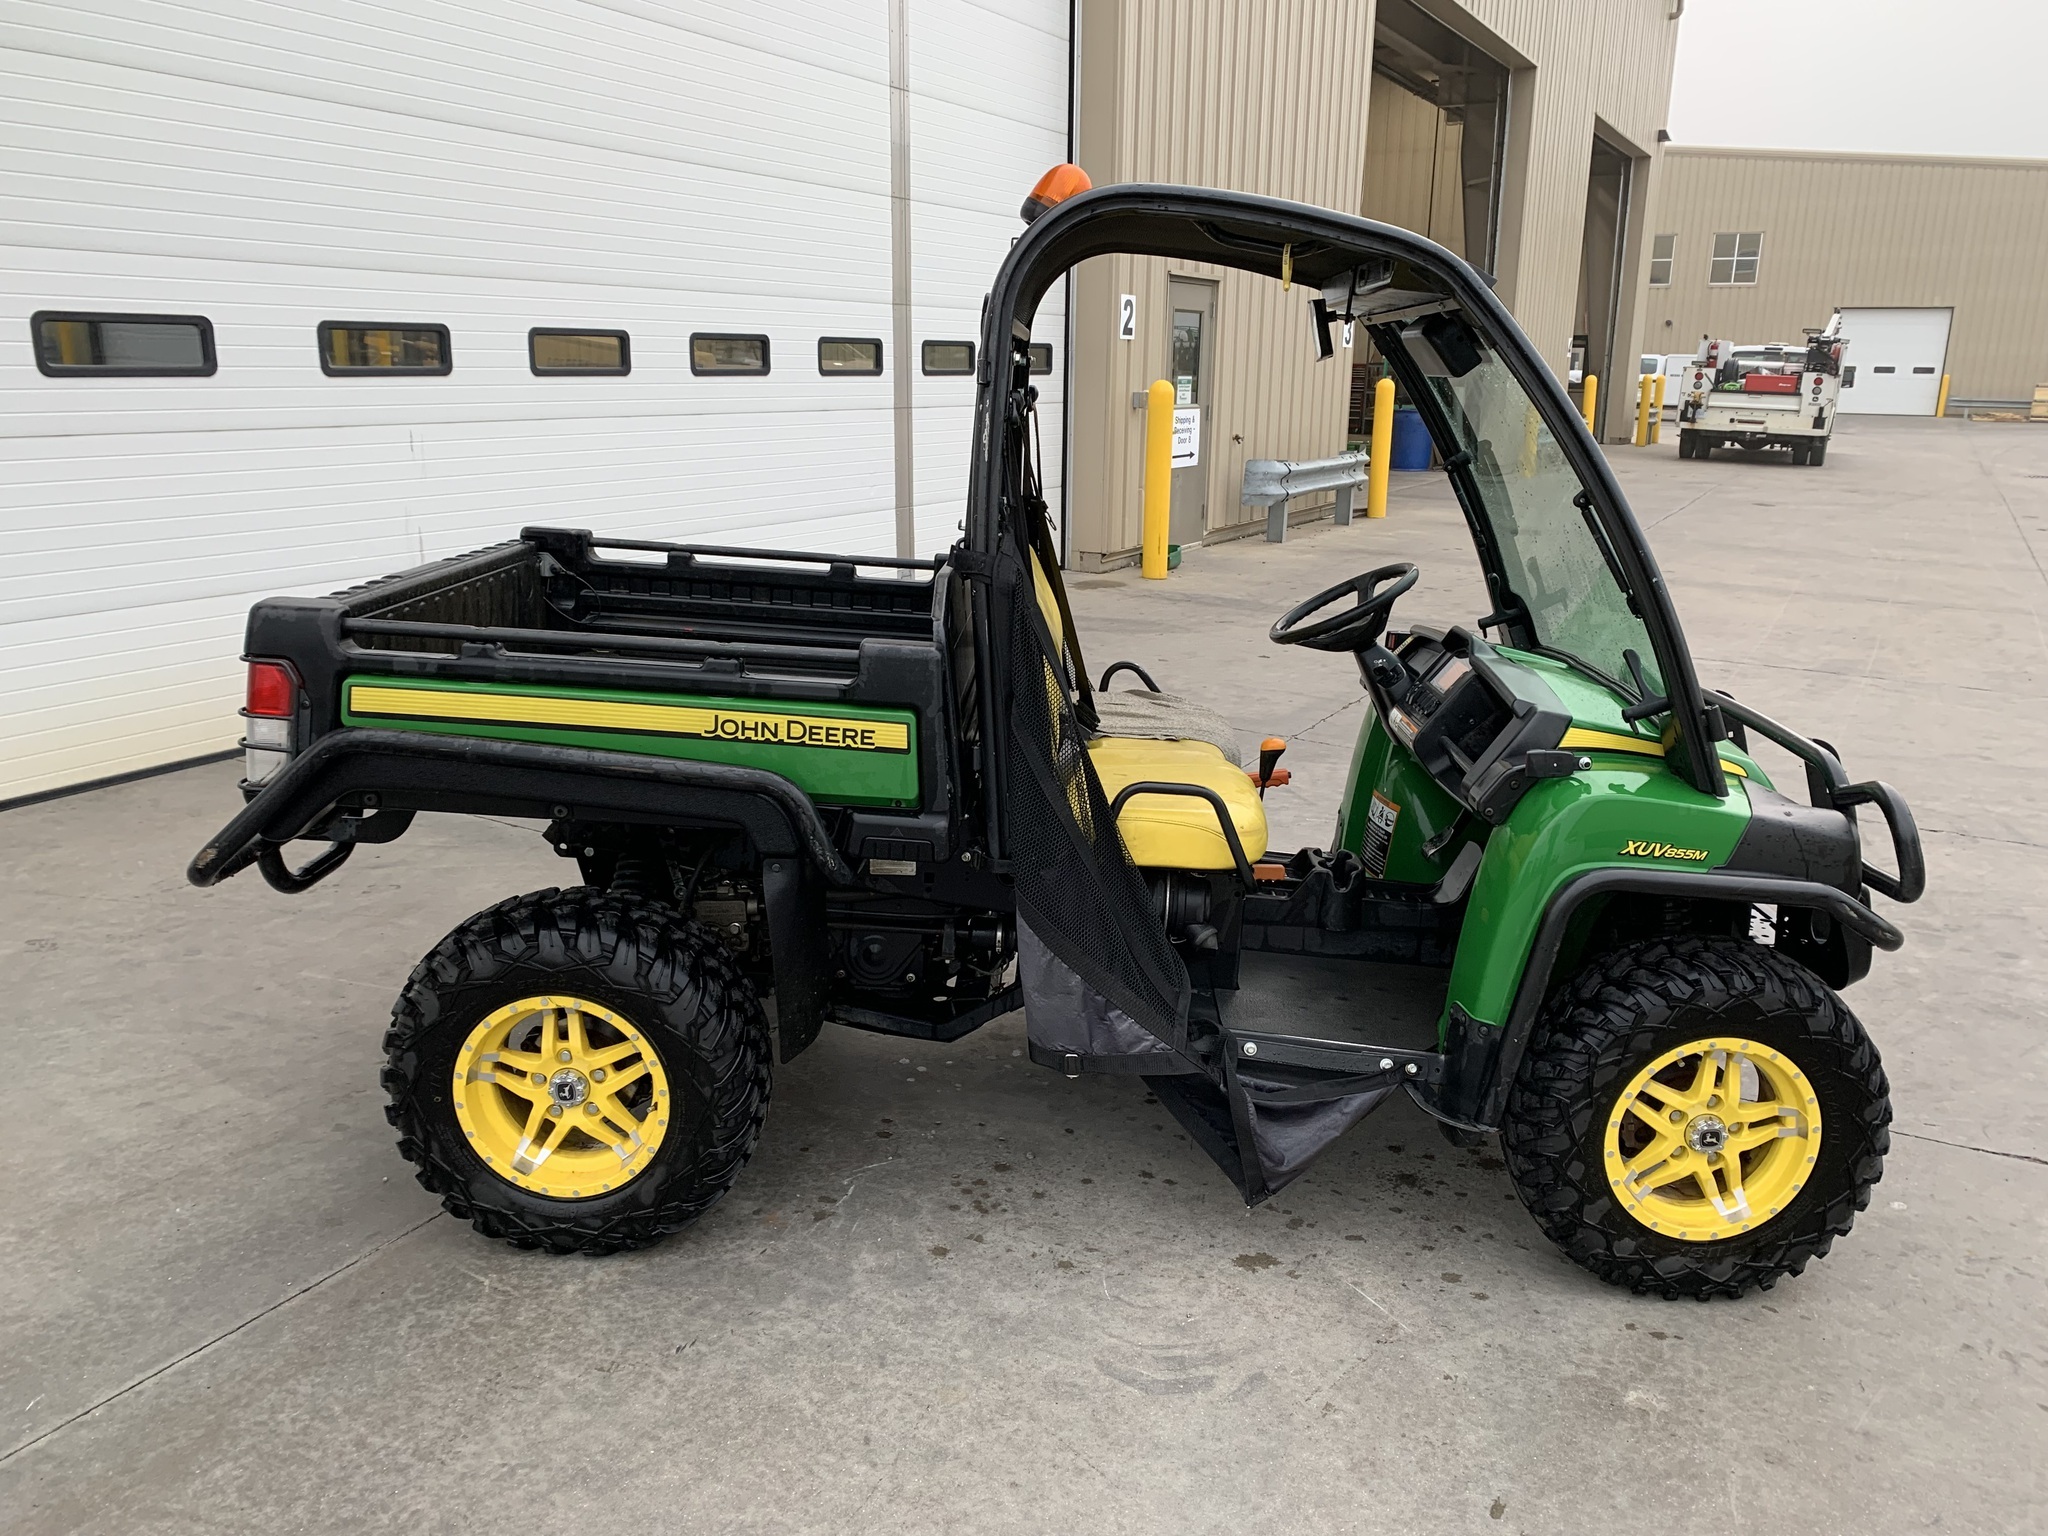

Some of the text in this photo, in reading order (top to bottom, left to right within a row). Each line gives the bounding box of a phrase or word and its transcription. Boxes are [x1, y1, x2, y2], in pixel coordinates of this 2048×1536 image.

[1123, 299, 1134, 336] 2
[1175, 416, 1191, 425] Shipping
[1174, 426, 1192, 435] Receiving
[1178, 436, 1187, 444] Door
[704, 714, 876, 746] JOHN DEERE
[1619, 840, 1709, 861] XUV855M
